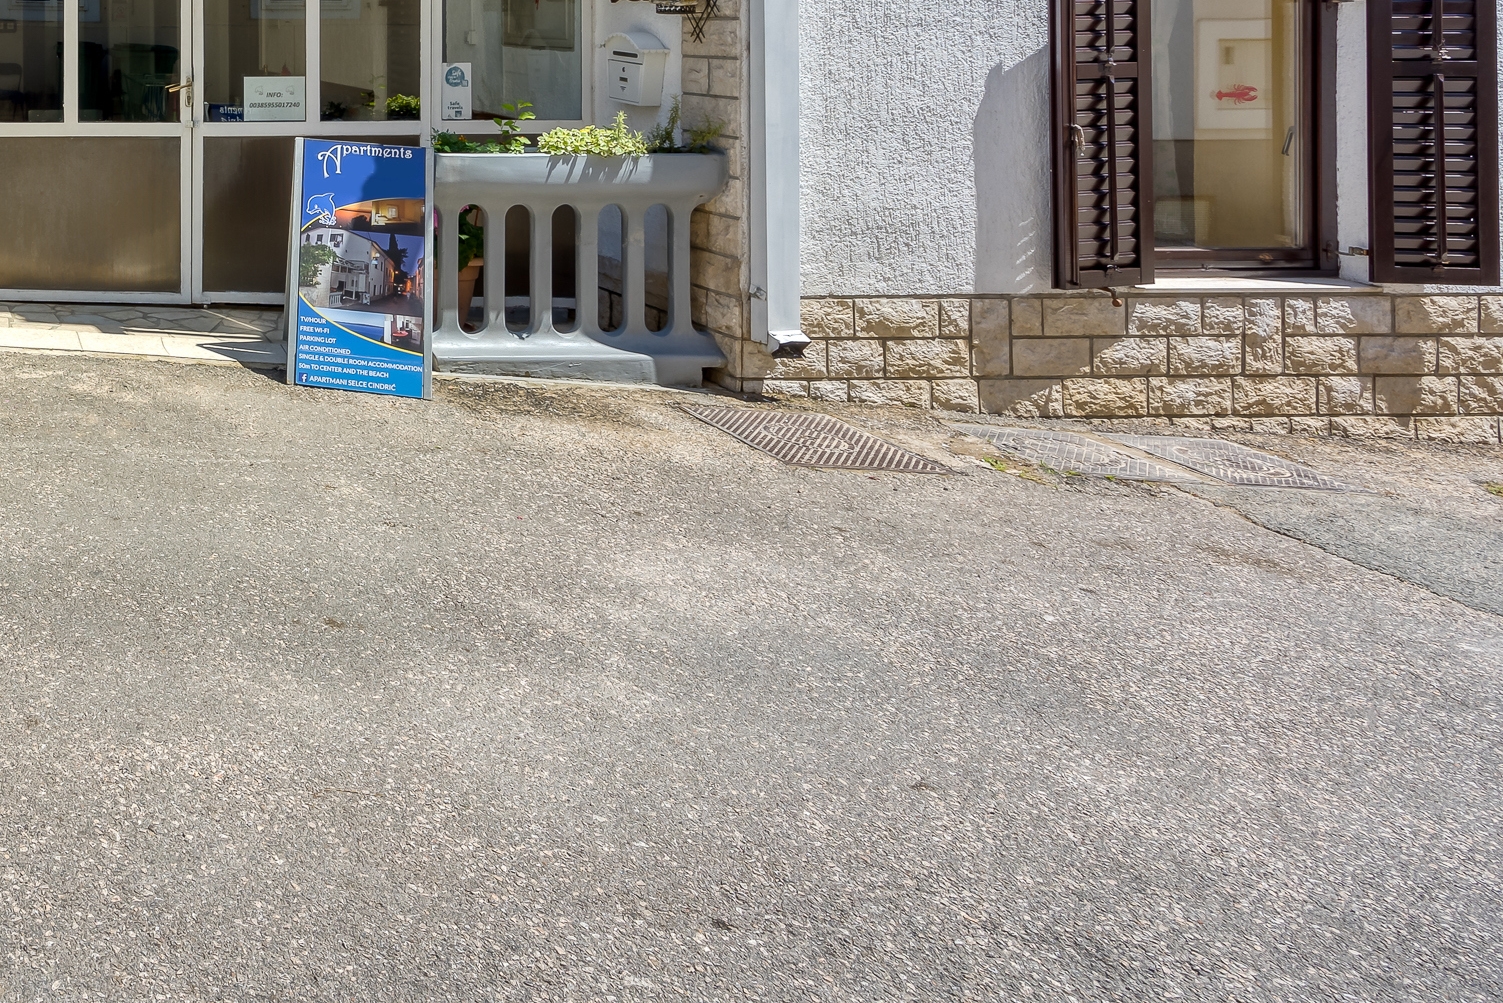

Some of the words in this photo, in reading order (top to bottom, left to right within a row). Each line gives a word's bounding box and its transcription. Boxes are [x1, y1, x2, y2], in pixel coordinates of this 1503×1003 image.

[318, 145, 413, 178] Apartments
[299, 325, 314, 333] FREE
[299, 335, 325, 343] PARKING
[309, 345, 351, 355] CONDITIONED
[298, 353, 319, 361] SINGLE
[324, 356, 349, 364] DOUBLE
[348, 358, 368, 366] ROOM
[367, 360, 423, 373] ACCOMMODATION
[298, 362, 311, 370] 50m
[319, 365, 343, 373] CENTER
[342, 367, 357, 375] AND
[356, 369, 369, 377] THE
[368, 370, 389, 379] BEACH
[309, 375, 348, 386] APARTMANI
[347, 380, 368, 389] SELCE
[367, 382, 397, 392] CINDRIĆ
